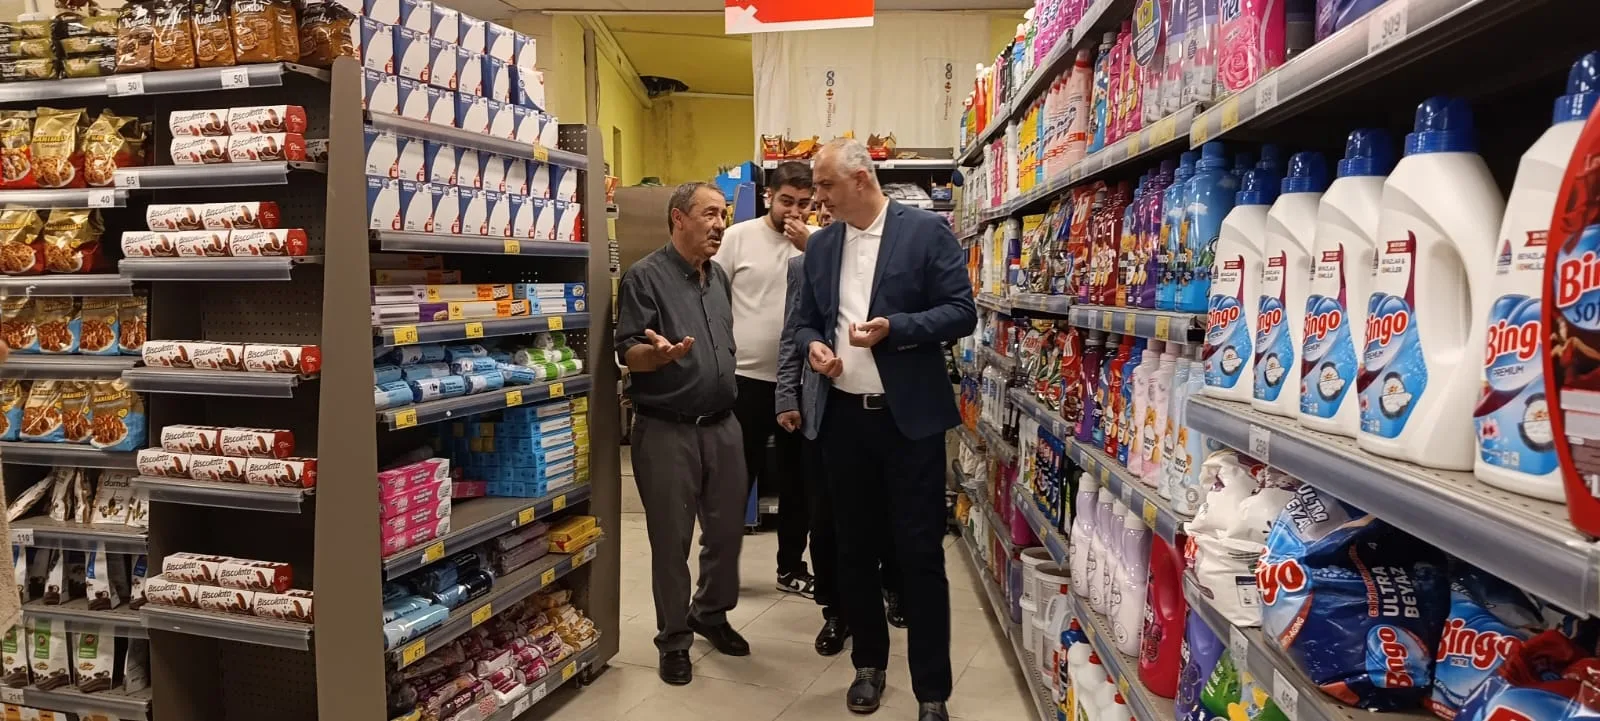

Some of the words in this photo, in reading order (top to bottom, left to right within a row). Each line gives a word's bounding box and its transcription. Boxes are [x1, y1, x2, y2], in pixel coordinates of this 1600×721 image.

[235, 75, 243, 83] 50
[1486, 318, 1542, 367] Bing
[1297, 483, 1329, 523] ULTRA
[1286, 497, 1313, 534] EYA
[166, 561, 197, 571] Biscolata
[220, 569, 251, 579] Biscolata
[201, 591, 232, 600] Biscolata
[1371, 566, 1399, 617] ULTRA
[1389, 566, 1420, 618] BEYAZ
[256, 599, 289, 609] Biscolata
